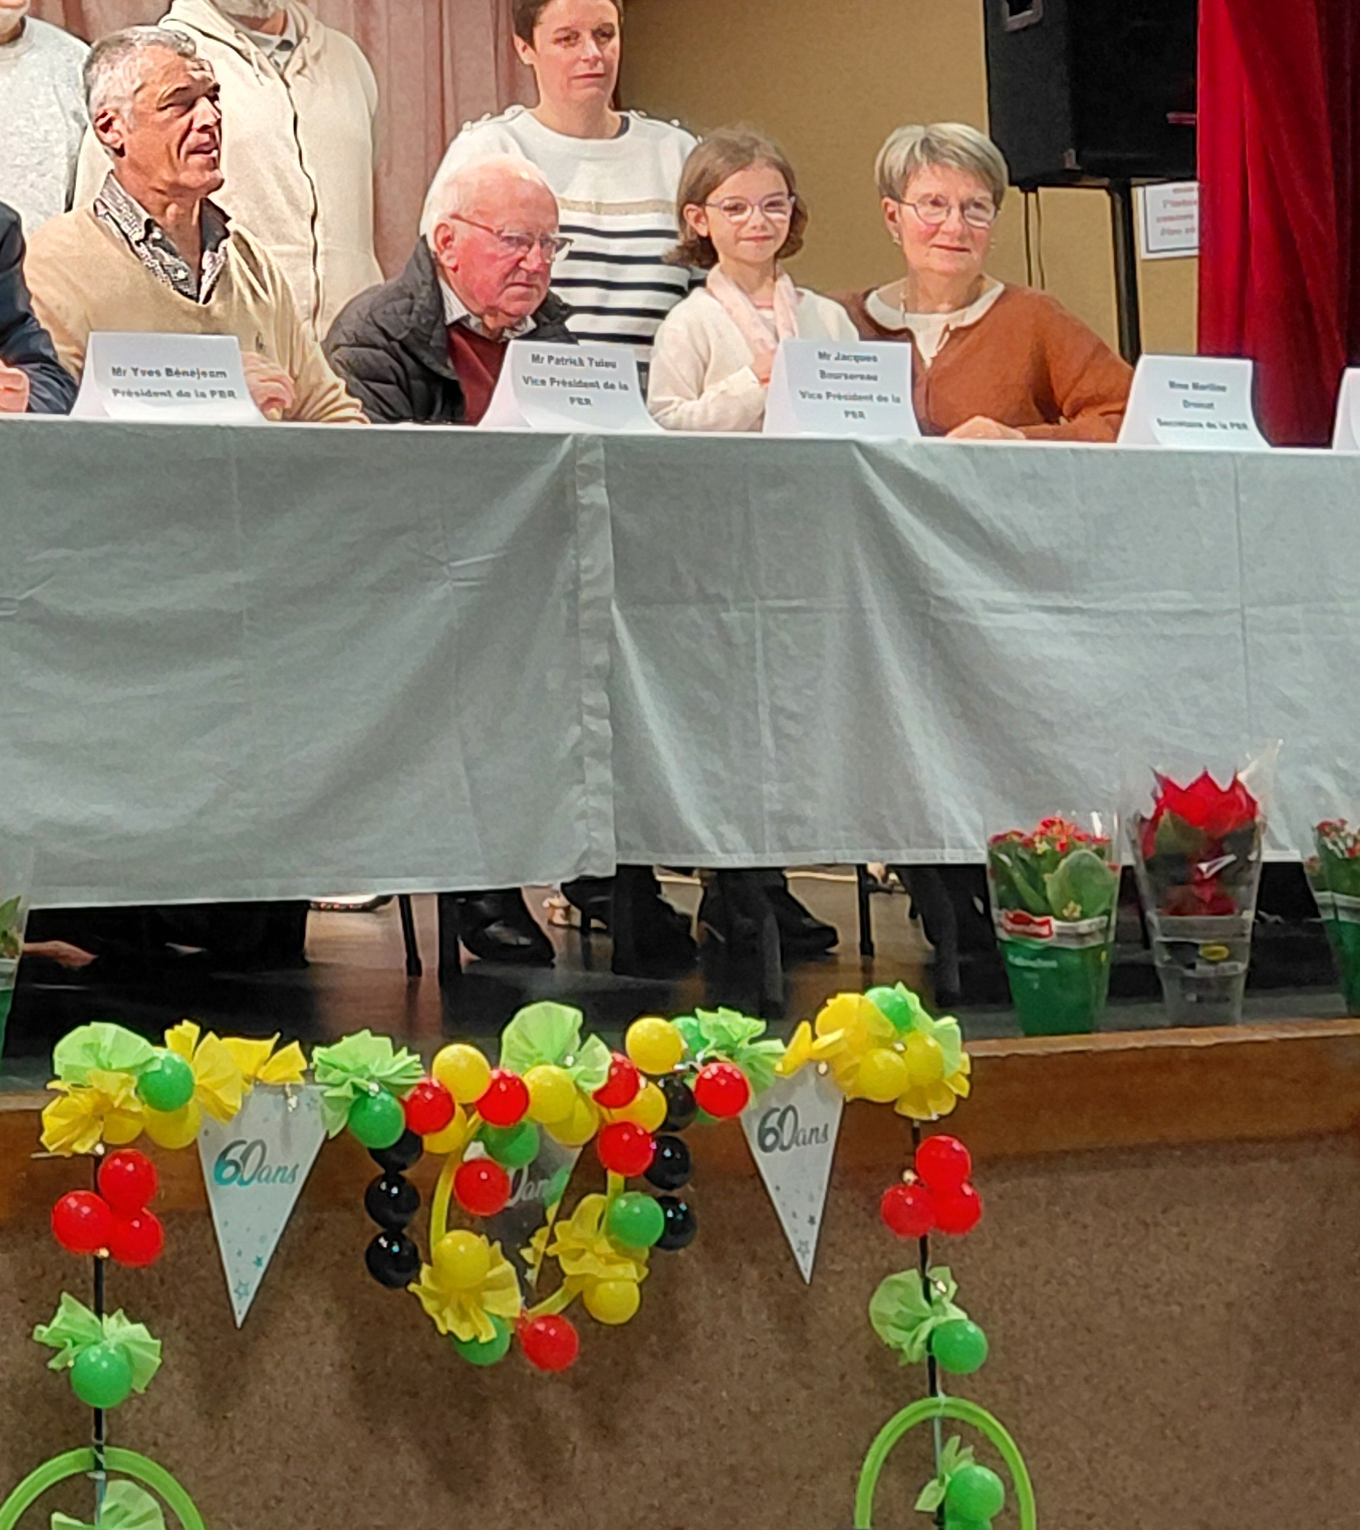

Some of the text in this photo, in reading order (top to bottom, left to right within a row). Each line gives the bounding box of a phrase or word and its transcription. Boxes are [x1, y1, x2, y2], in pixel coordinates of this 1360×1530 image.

[531, 354, 545, 364] Mr
[547, 355, 585, 367] Patrick
[112, 367, 127, 377] Mr
[132, 367, 162, 378] Yves
[522, 376, 547, 386] Vice
[603, 380, 616, 390] de
[619, 381, 629, 391] la
[176, 389, 191, 399] de
[195, 389, 207, 399] la
[799, 390, 823, 401] Vice
[876, 393, 889, 403] de
[891, 394, 901, 404] la
